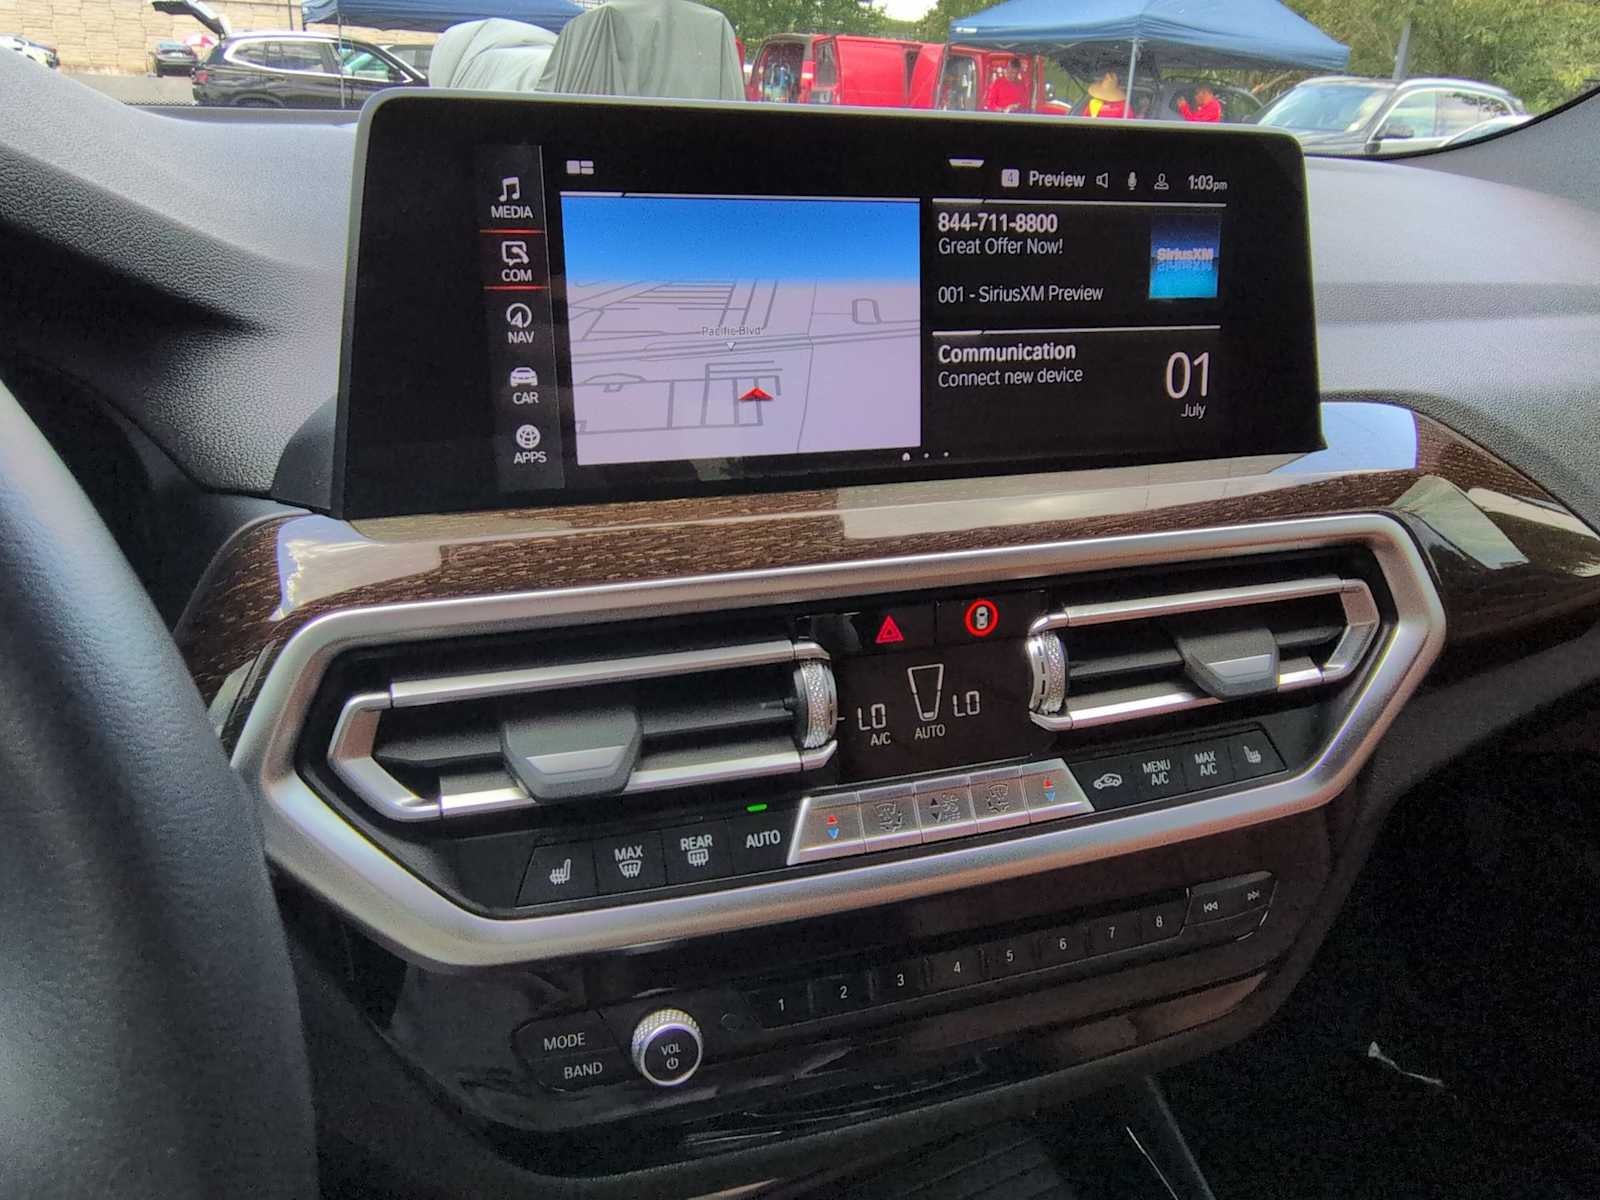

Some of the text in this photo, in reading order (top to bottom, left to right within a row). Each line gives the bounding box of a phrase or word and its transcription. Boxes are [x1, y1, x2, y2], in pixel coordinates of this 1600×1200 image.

[1029, 170, 1085, 187] Preview
[1188, 175, 1227, 190] 1:03pm
[491, 205, 533, 219] MEDIA
[938, 213, 1058, 232] 844-711-8800
[938, 238, 1063, 254] Great Offer Now!
[501, 269, 532, 282] COM
[938, 286, 964, 303] 001
[979, 285, 1045, 302] SiriusXM
[1049, 285, 1103, 301] Preview
[508, 331, 534, 344] NAV
[938, 343, 1076, 364] Communication
[938, 367, 1083, 387] Connect new device
[1166, 351, 1210, 399] 01
[513, 391, 538, 405] CAR
[1181, 403, 1206, 419] July
[514, 451, 547, 464] APPS
[952, 691, 980, 717] LO
[857, 703, 887, 731] LO
[870, 732, 891, 746] A/C
[914, 724, 946, 740] AUTO
[1194, 750, 1216, 764] MAX
[1142, 759, 1171, 774] MENU
[1200, 762, 1217, 777] A/C
[1151, 772, 1169, 786] A/C
[680, 834, 713, 851] REAR
[746, 829, 780, 848] AUTO
[614, 845, 643, 862] MAX
[840, 985, 848, 999] 2
[897, 974, 904, 986] 3
[953, 961, 961, 974] 4
[1006, 950, 1014, 962] 5
[1059, 937, 1067, 950] 6
[1109, 926, 1116, 939] 7
[1156, 915, 1163, 928] 8
[544, 1032, 586, 1051] MODE
[661, 1043, 681, 1056] VOL
[564, 1062, 603, 1080] BAND
